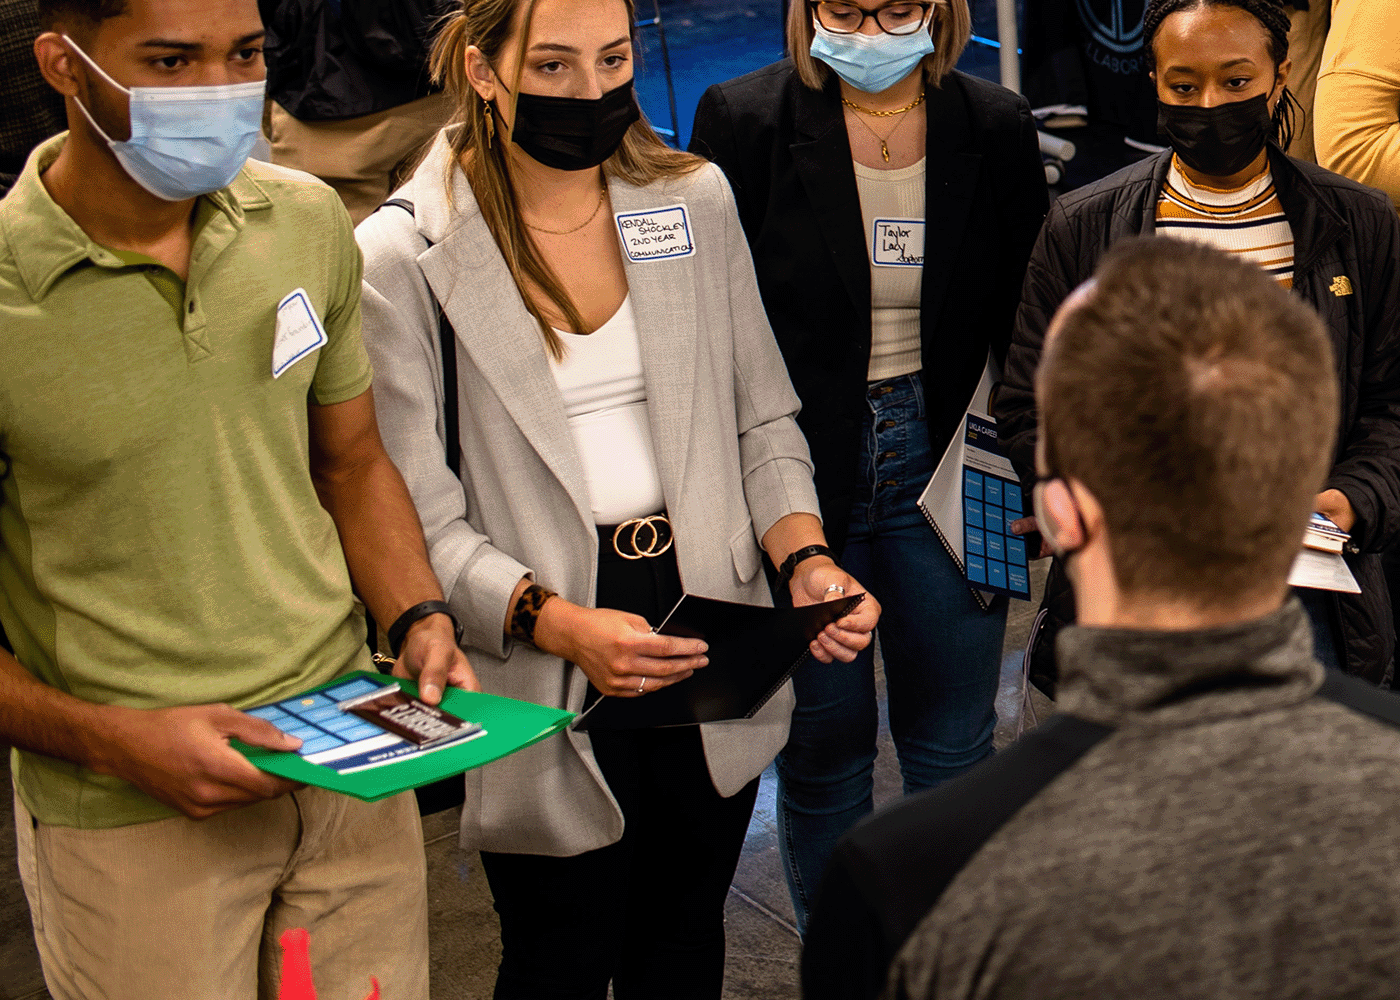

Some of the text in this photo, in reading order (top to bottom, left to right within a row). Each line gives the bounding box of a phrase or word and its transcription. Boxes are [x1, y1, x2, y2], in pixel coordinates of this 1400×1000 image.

[620, 218, 657, 229] KENDALL
[638, 222, 685, 235] SHOCKLEY
[631, 233, 676, 246] 2ND YEAR
[878, 224, 911, 246] Taylor
[883, 239, 906, 257] Lacy
